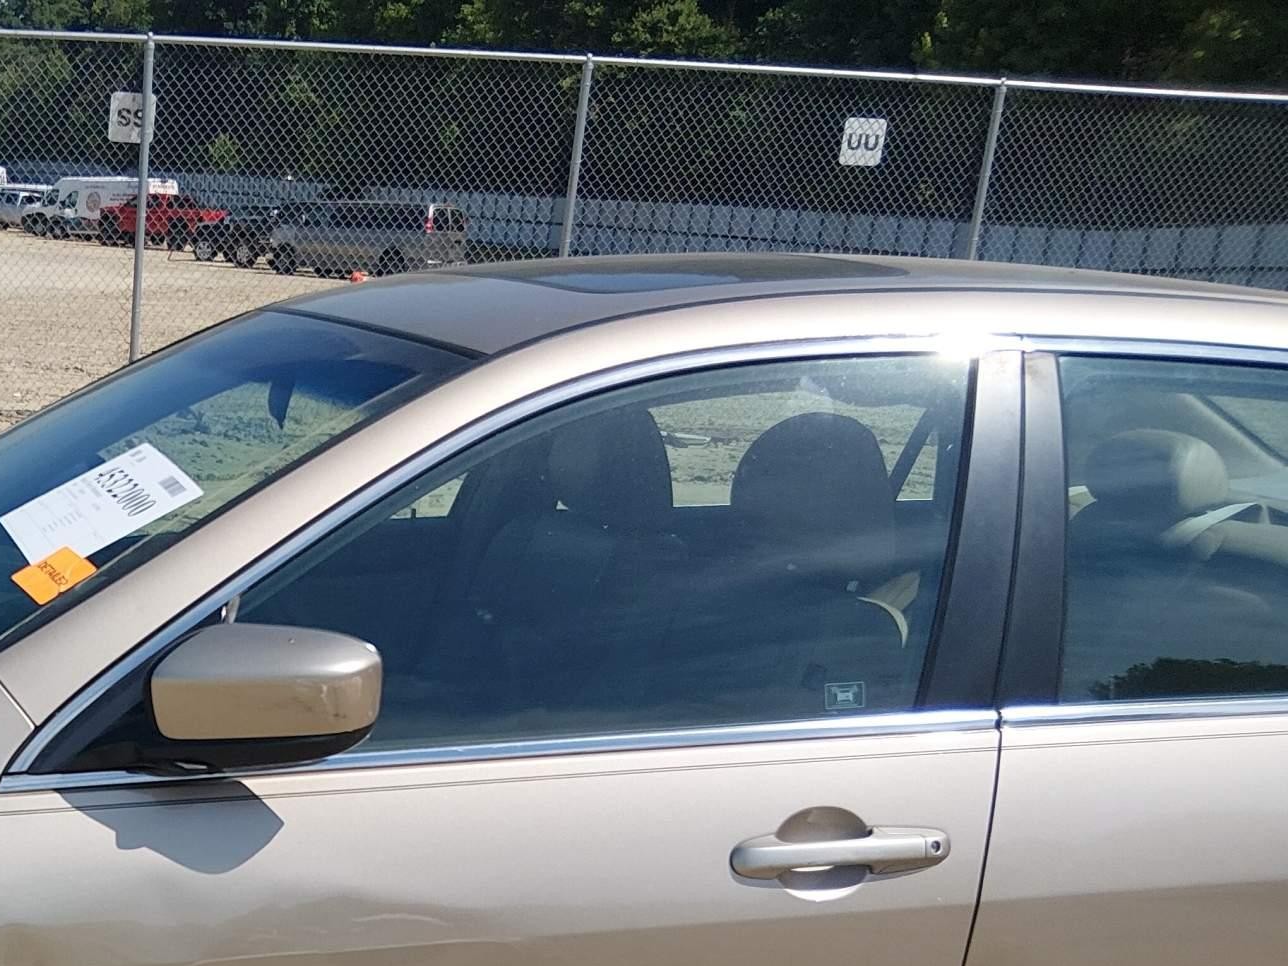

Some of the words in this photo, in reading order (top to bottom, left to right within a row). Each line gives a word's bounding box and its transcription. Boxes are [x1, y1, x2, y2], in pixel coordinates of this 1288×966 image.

[117, 107, 144, 128] SS
[847, 132, 880, 151] UU
[94, 466, 157, 517] 45322000
